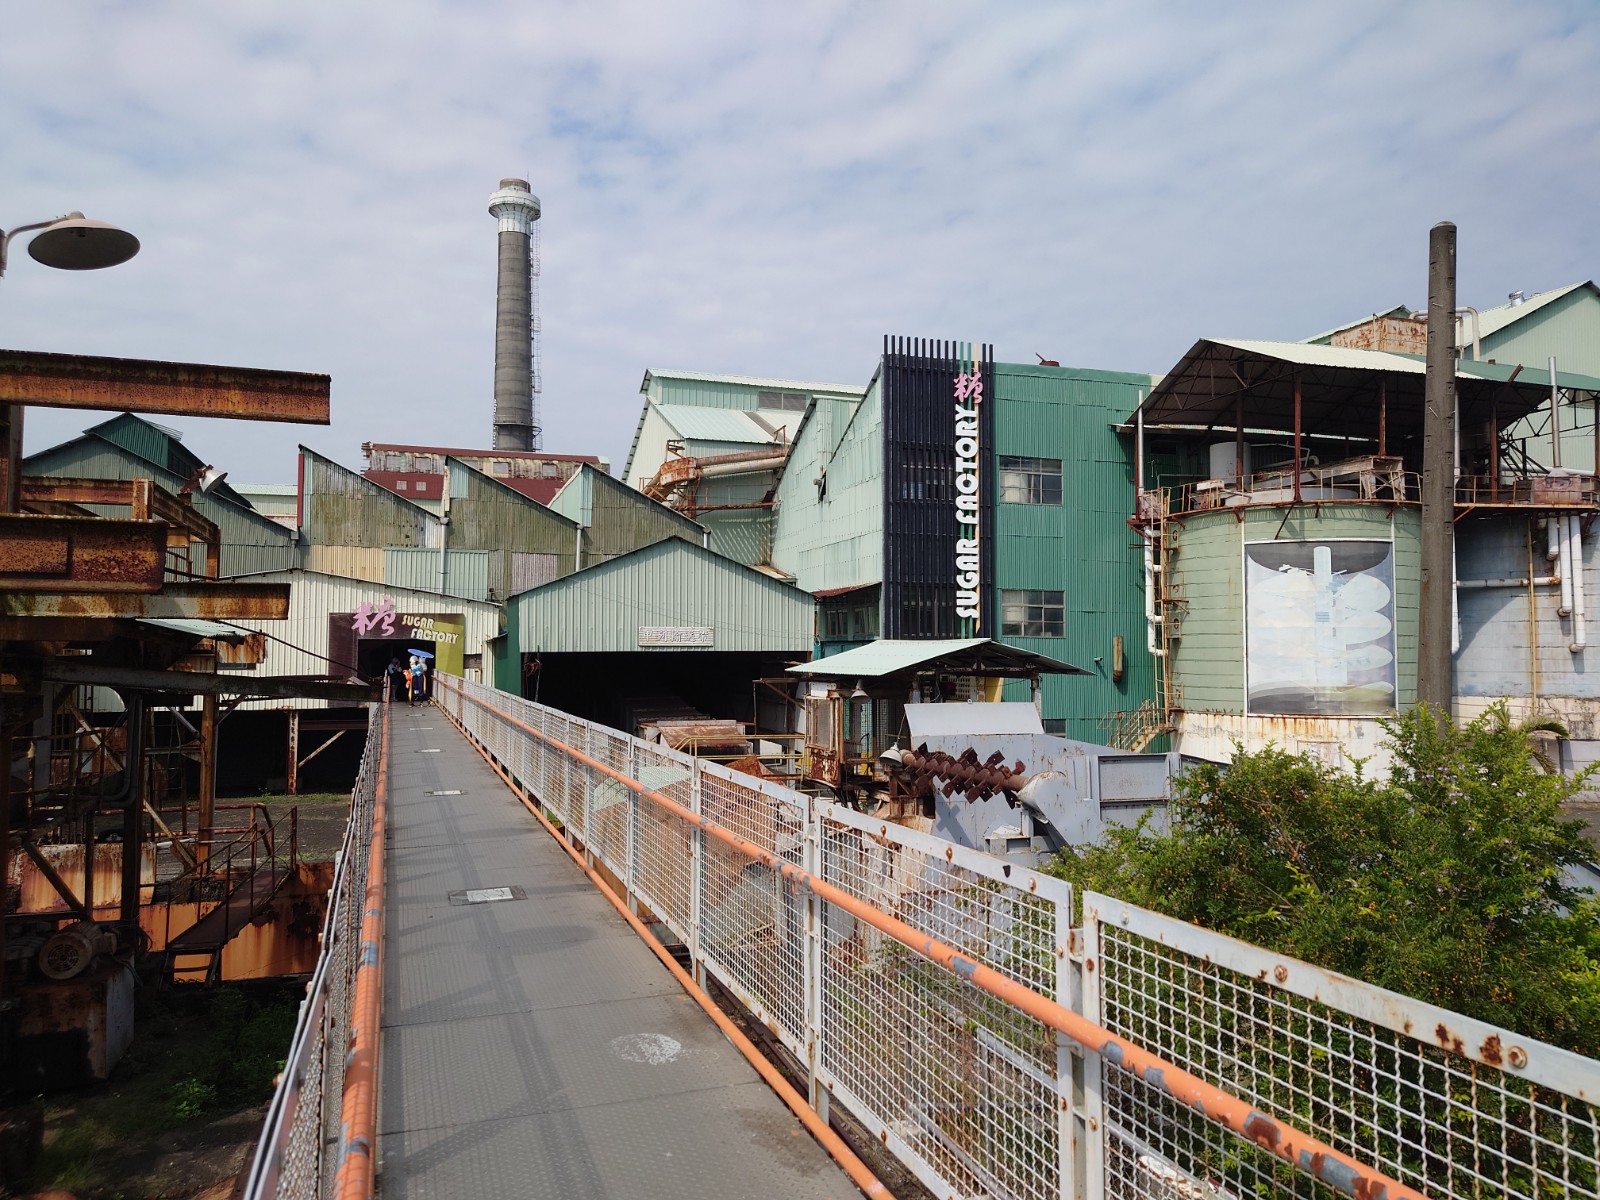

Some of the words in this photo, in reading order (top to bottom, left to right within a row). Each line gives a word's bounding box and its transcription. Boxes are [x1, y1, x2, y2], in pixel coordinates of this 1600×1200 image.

[953, 368, 984, 404] 糖
[955, 404, 979, 525] FACTORY
[955, 538, 980, 620] SUGAR
[351, 594, 396, 637] 糖
[402, 614, 435, 629] SUGAR
[410, 628, 459, 645] FACTORY
